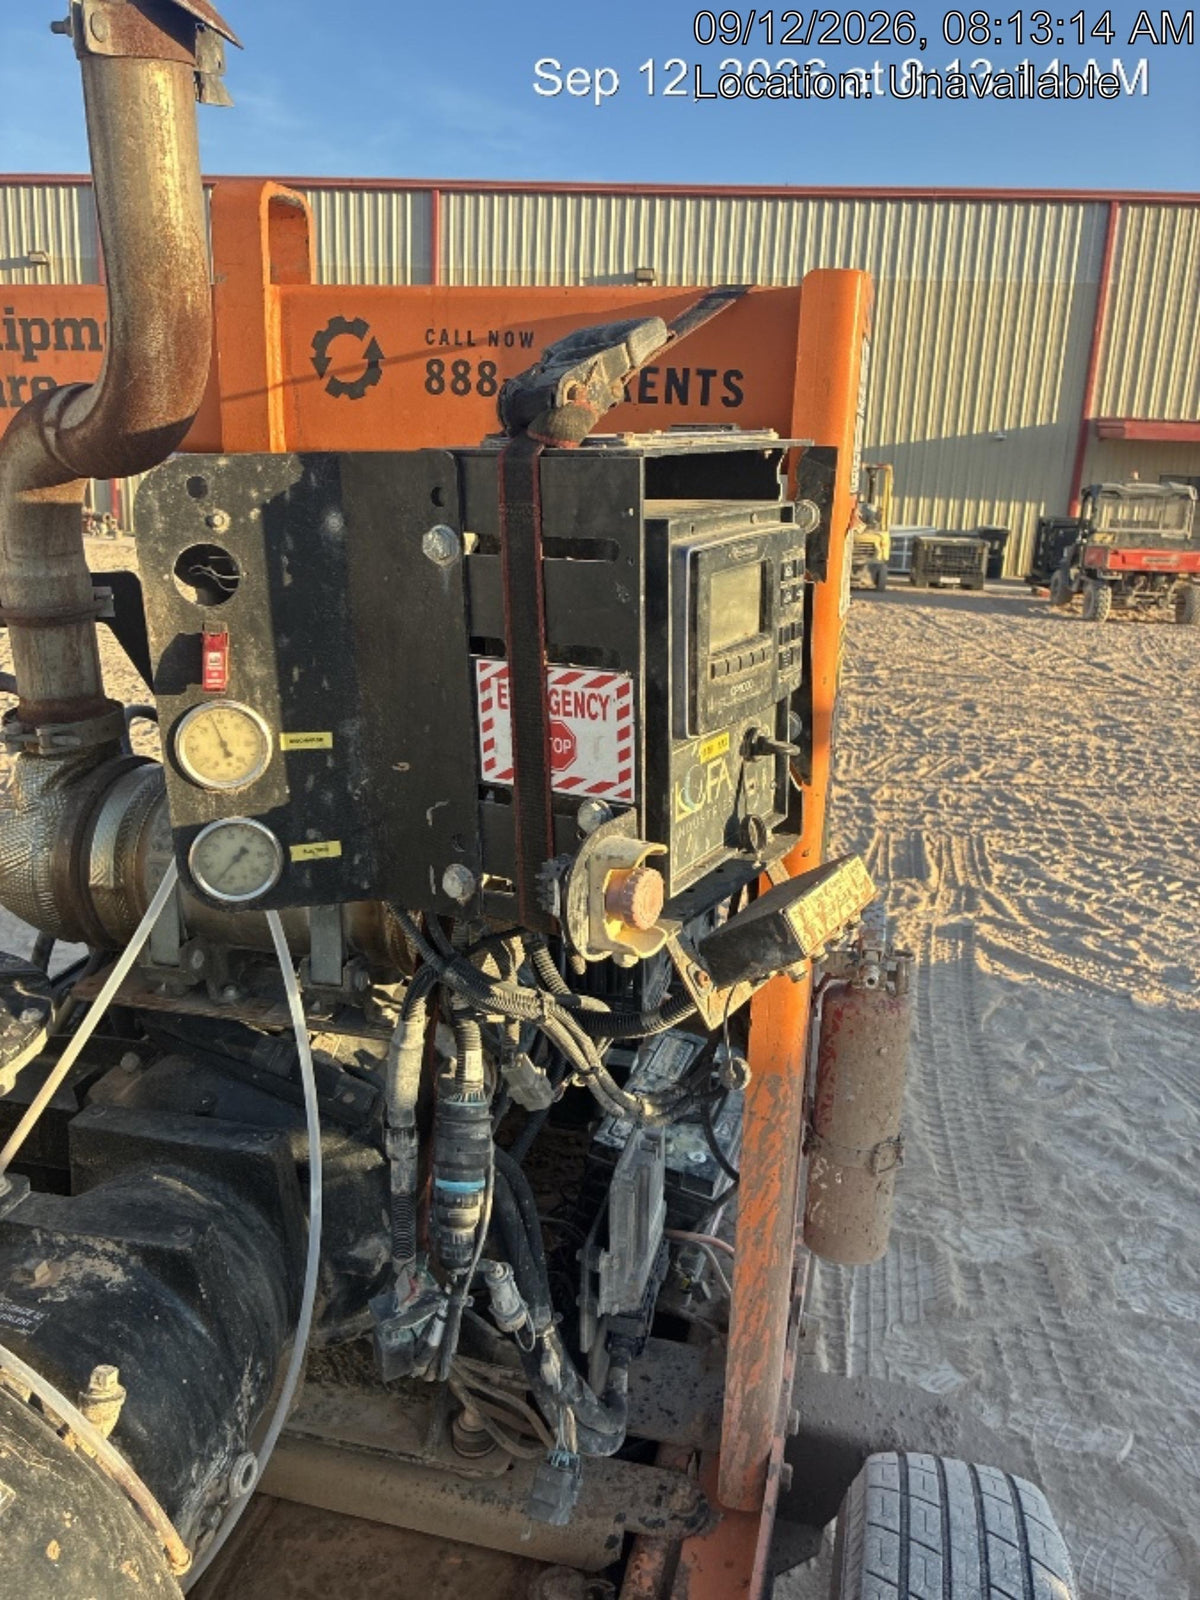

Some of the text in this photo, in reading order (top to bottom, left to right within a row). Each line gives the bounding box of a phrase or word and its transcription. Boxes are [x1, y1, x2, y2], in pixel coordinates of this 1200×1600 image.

[425, 328, 534, 348] CALL NOW
[624, 366, 744, 408] ENTS
[497, 682, 610, 721] EGENCY
